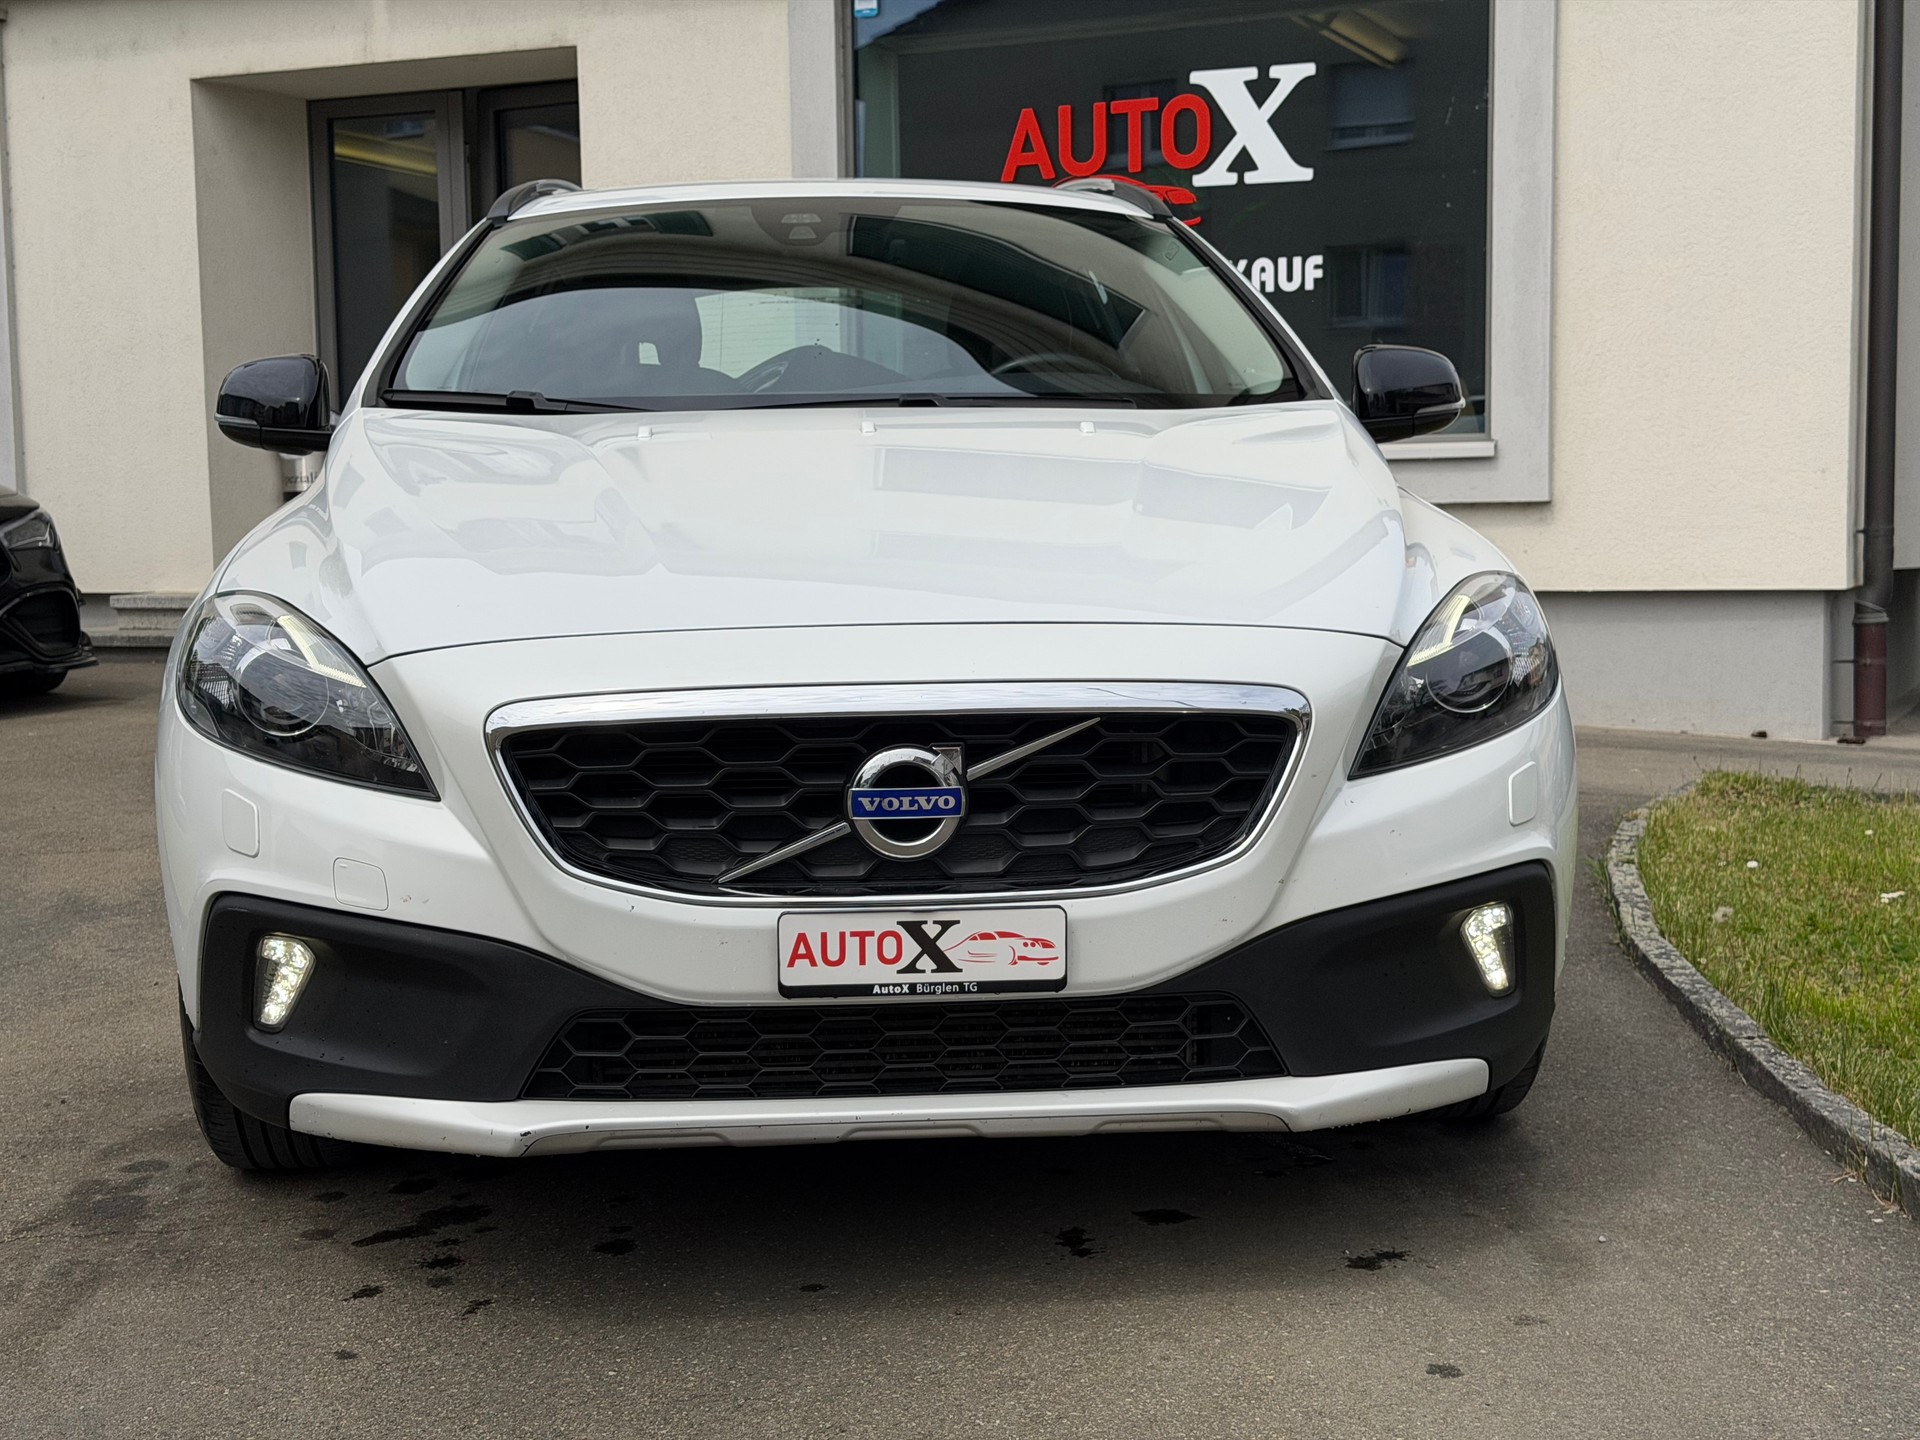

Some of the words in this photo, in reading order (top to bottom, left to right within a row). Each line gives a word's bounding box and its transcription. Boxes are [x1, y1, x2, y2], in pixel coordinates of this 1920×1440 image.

[858, 795, 956, 812] VOLVO
[872, 984, 910, 994] AutoX
[916, 983, 959, 995] Bürglen
[963, 982, 978, 992] TG
